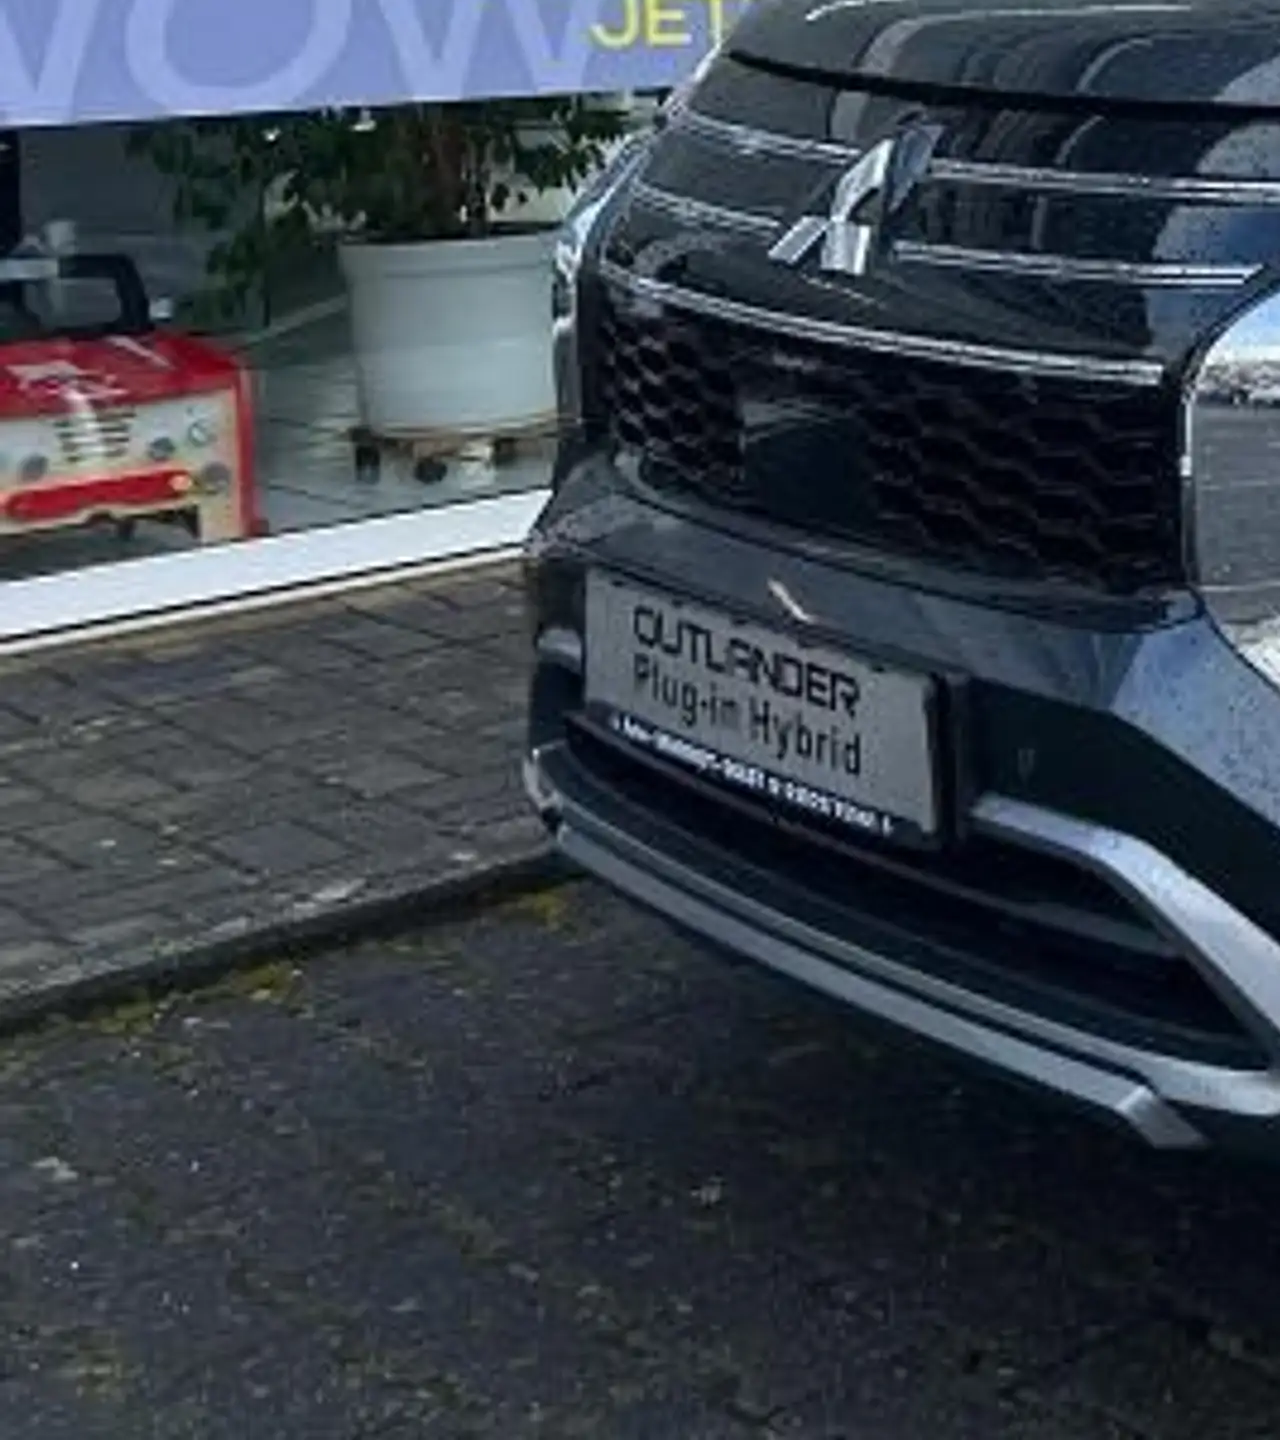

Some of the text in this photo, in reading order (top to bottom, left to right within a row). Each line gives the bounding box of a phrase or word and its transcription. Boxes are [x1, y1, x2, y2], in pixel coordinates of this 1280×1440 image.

[632, 604, 861, 717] OUTLANDER
[633, 652, 739, 726] Plug-in
[750, 694, 862, 777] Hybrid
